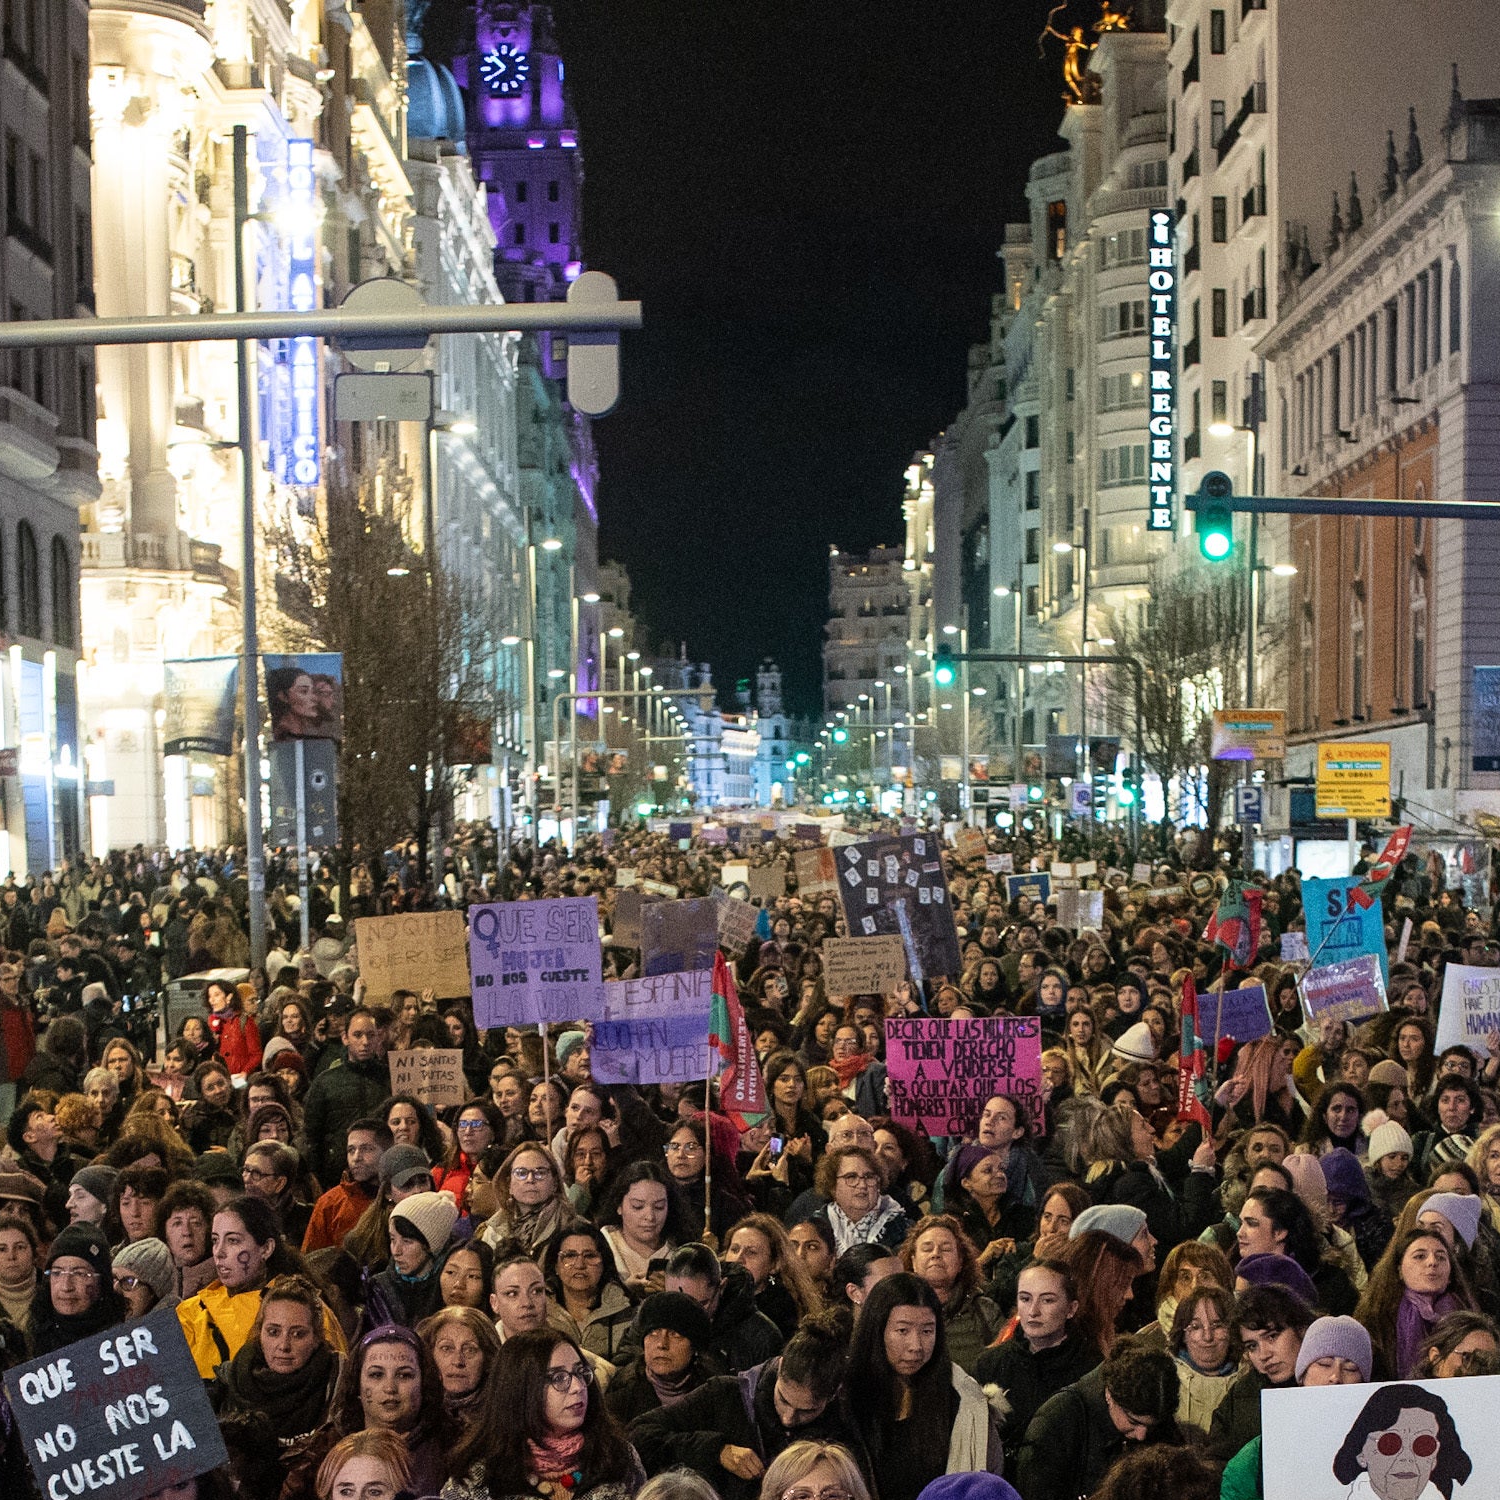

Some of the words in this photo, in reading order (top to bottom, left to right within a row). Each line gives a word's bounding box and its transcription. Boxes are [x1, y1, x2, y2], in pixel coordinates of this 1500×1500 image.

[1148, 248, 1174, 360] HOTEL
[1148, 370, 1174, 528] REGENTE
[1239, 788, 1259, 813] P
[473, 907, 537, 950] QUE
[545, 904, 594, 944] SER
[475, 974, 494, 987] NO
[502, 971, 528, 985] NOS
[539, 969, 590, 983] CUESTE
[886, 1019, 925, 1040] DECIR
[927, 1019, 952, 1040] QUE
[955, 1019, 982, 1040] LAS
[982, 1017, 1040, 1039] MUJERES
[395, 1055, 415, 1068] NI
[418, 1055, 457, 1068] SANTAS
[901, 1040, 947, 1061] TIENEN
[952, 1038, 1017, 1060] DERECHO
[396, 1072, 412, 1084] NI
[914, 1061, 928, 1080] A
[940, 1058, 1017, 1079] VENDERSE
[891, 1079, 908, 1098] ES
[910, 1079, 970, 1098] OCULTAR
[972, 1078, 999, 1097] QUE
[1006, 1077, 1038, 1096] LOS
[18, 1358, 77, 1406] QUE
[99, 1326, 159, 1376] SER
[34, 1423, 77, 1463] NO
[105, 1384, 170, 1436] NOS
[152, 1420, 197, 1461] LA
